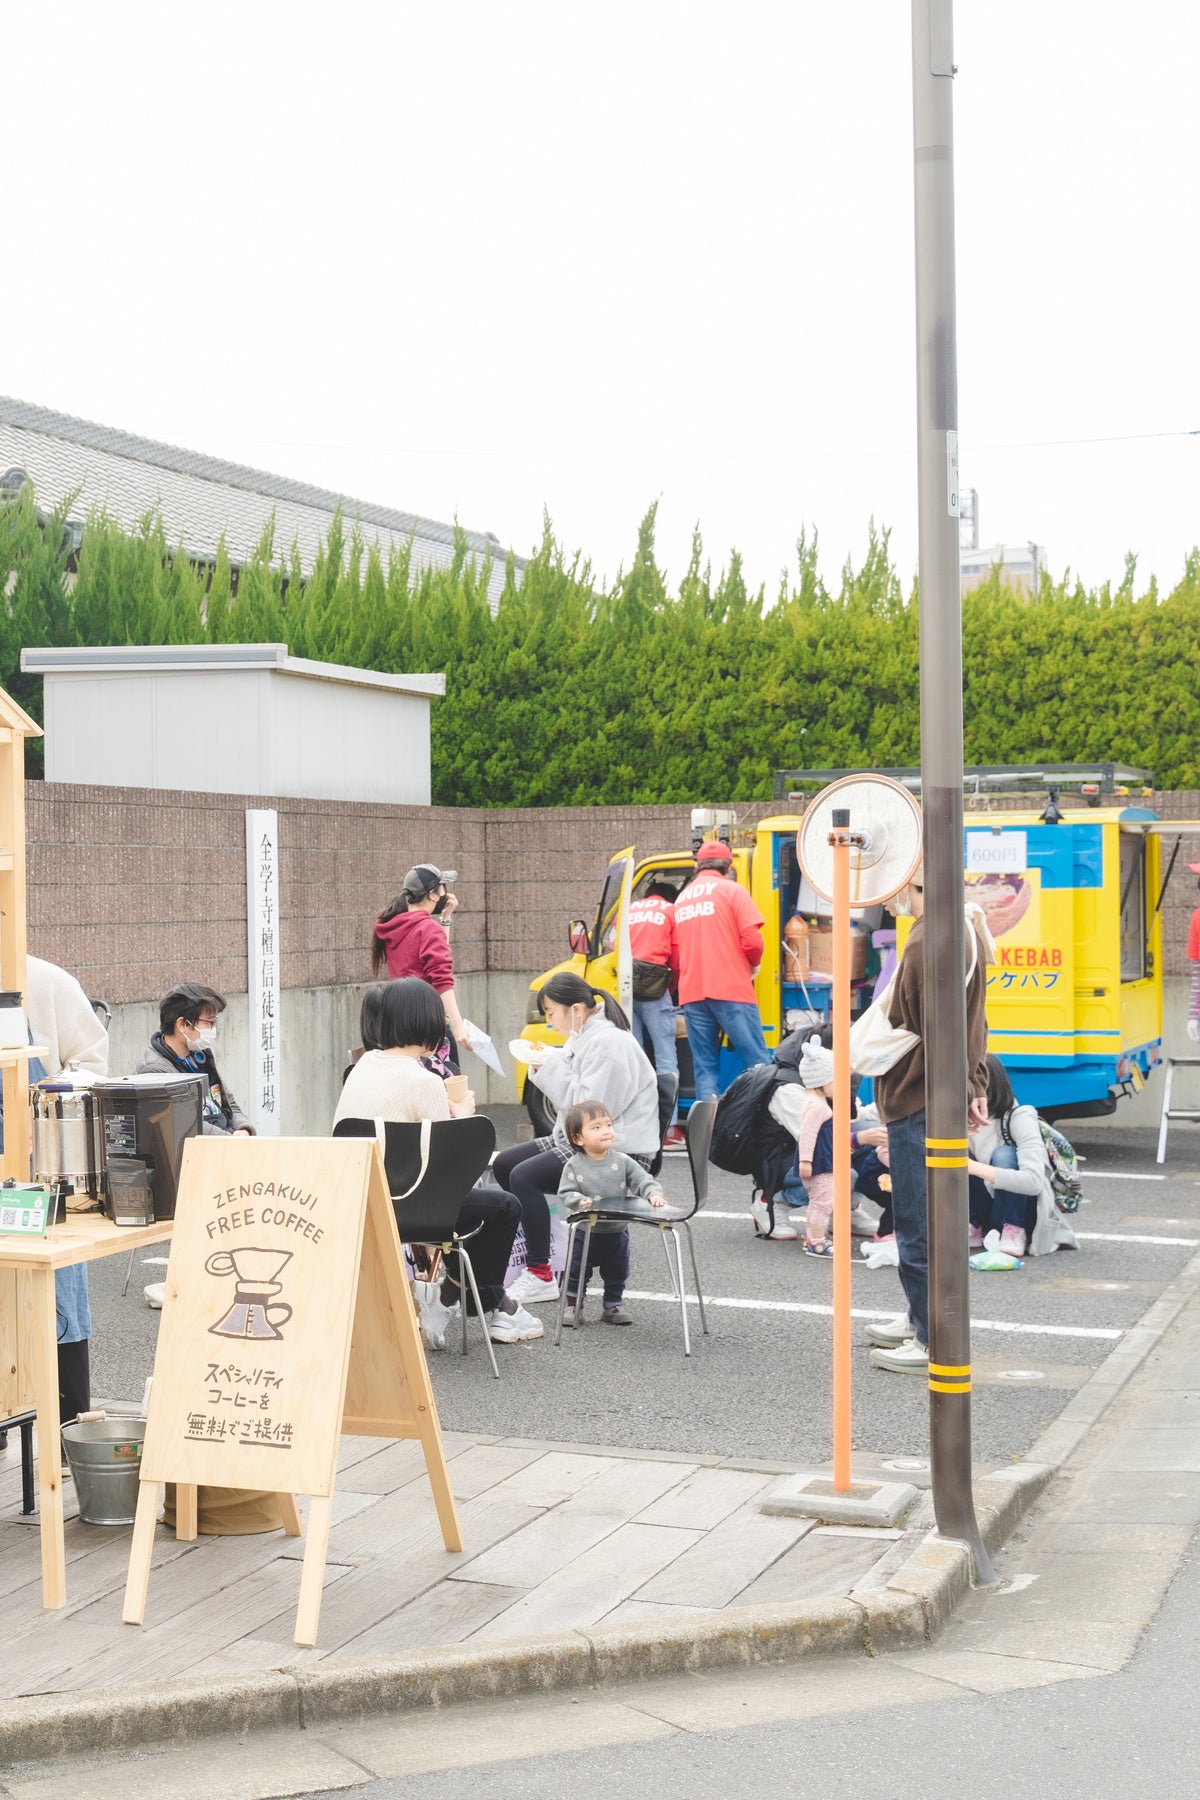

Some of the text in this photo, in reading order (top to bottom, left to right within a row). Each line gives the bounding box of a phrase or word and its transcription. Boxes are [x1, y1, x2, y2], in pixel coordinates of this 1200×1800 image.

[972, 847, 1017, 862] 600円
[628, 911, 666, 925] EBAB
[1001, 948, 1062, 967] KEBAB
[212, 1181, 319, 1211] ZENGAKUJI
[205, 1207, 325, 1245] FREE COFFEE
[204, 1363, 284, 1389] スペシャリティ
[208, 1389, 270, 1410] コーヒーを
[187, 1411, 294, 1442] 無料でご提供
